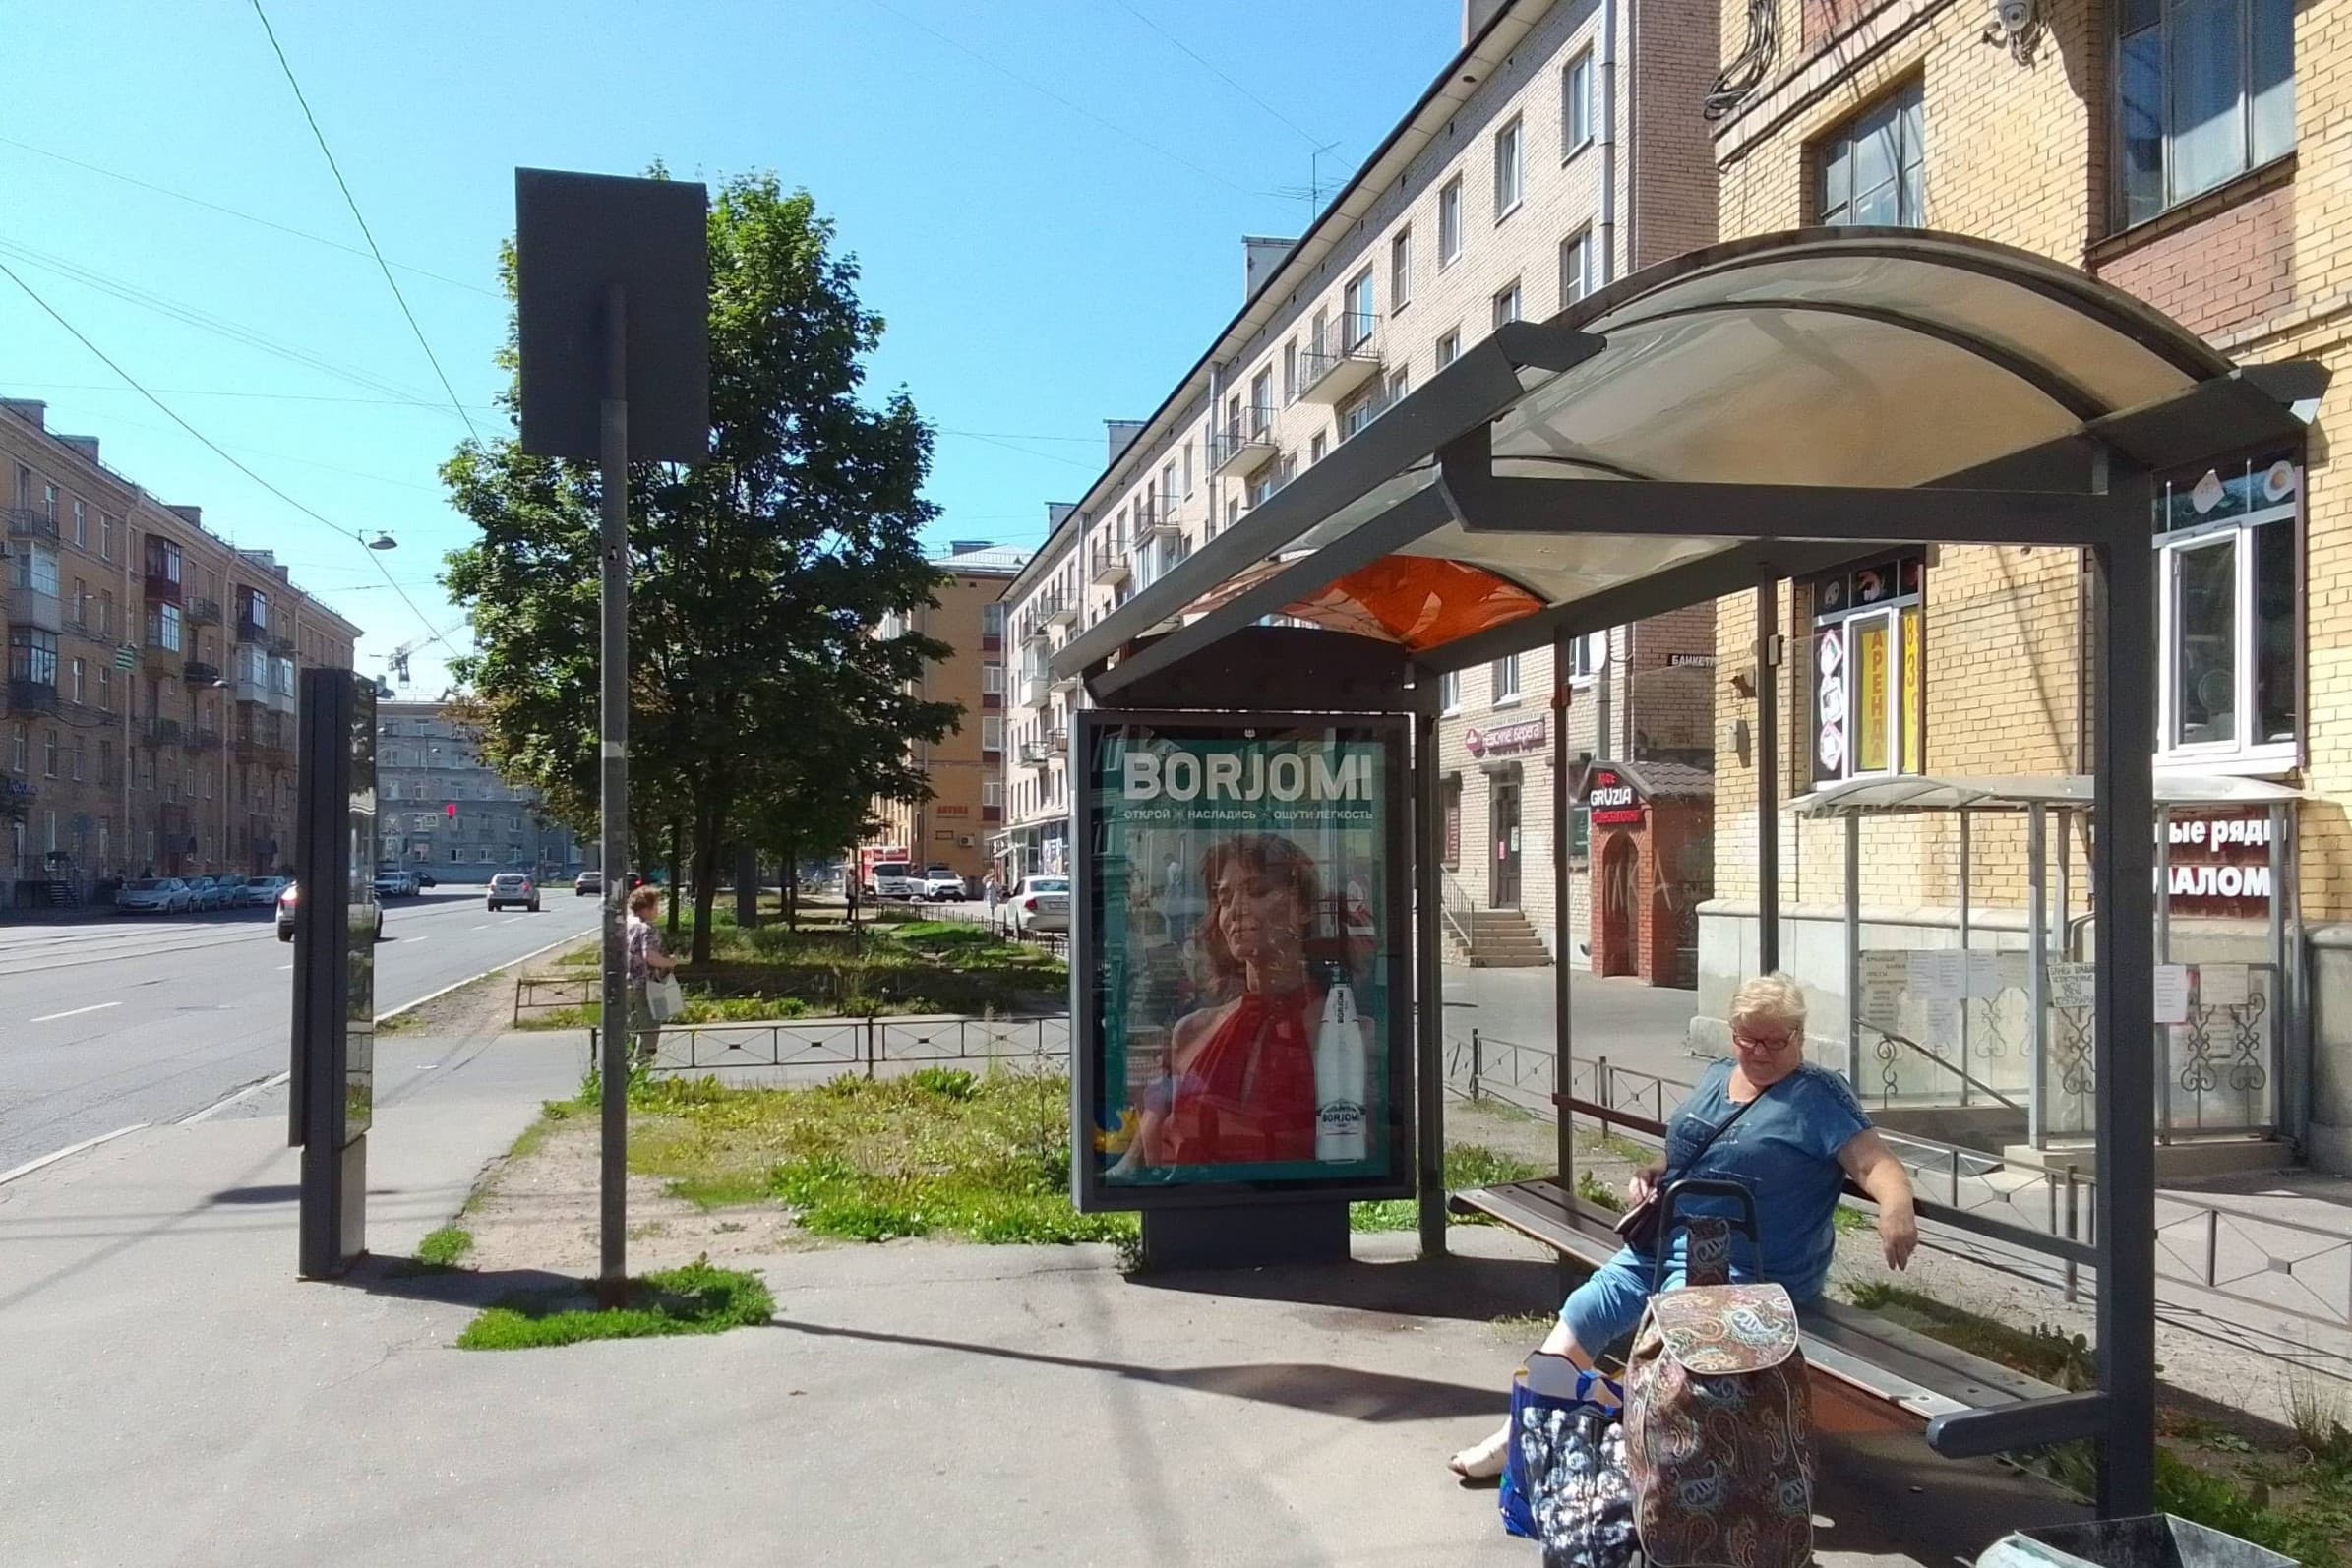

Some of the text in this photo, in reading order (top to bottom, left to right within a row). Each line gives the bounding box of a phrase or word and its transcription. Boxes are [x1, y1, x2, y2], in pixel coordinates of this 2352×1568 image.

[1123, 752, 1372, 801] BORJOMI
[1590, 787, 1632, 807] GRUZIA
[1124, 808, 1171, 819] ОТКРОЙ
[1187, 810, 1256, 820] НАСЛАДИСЬ
[1273, 810, 1315, 819] ОЩУТИ
